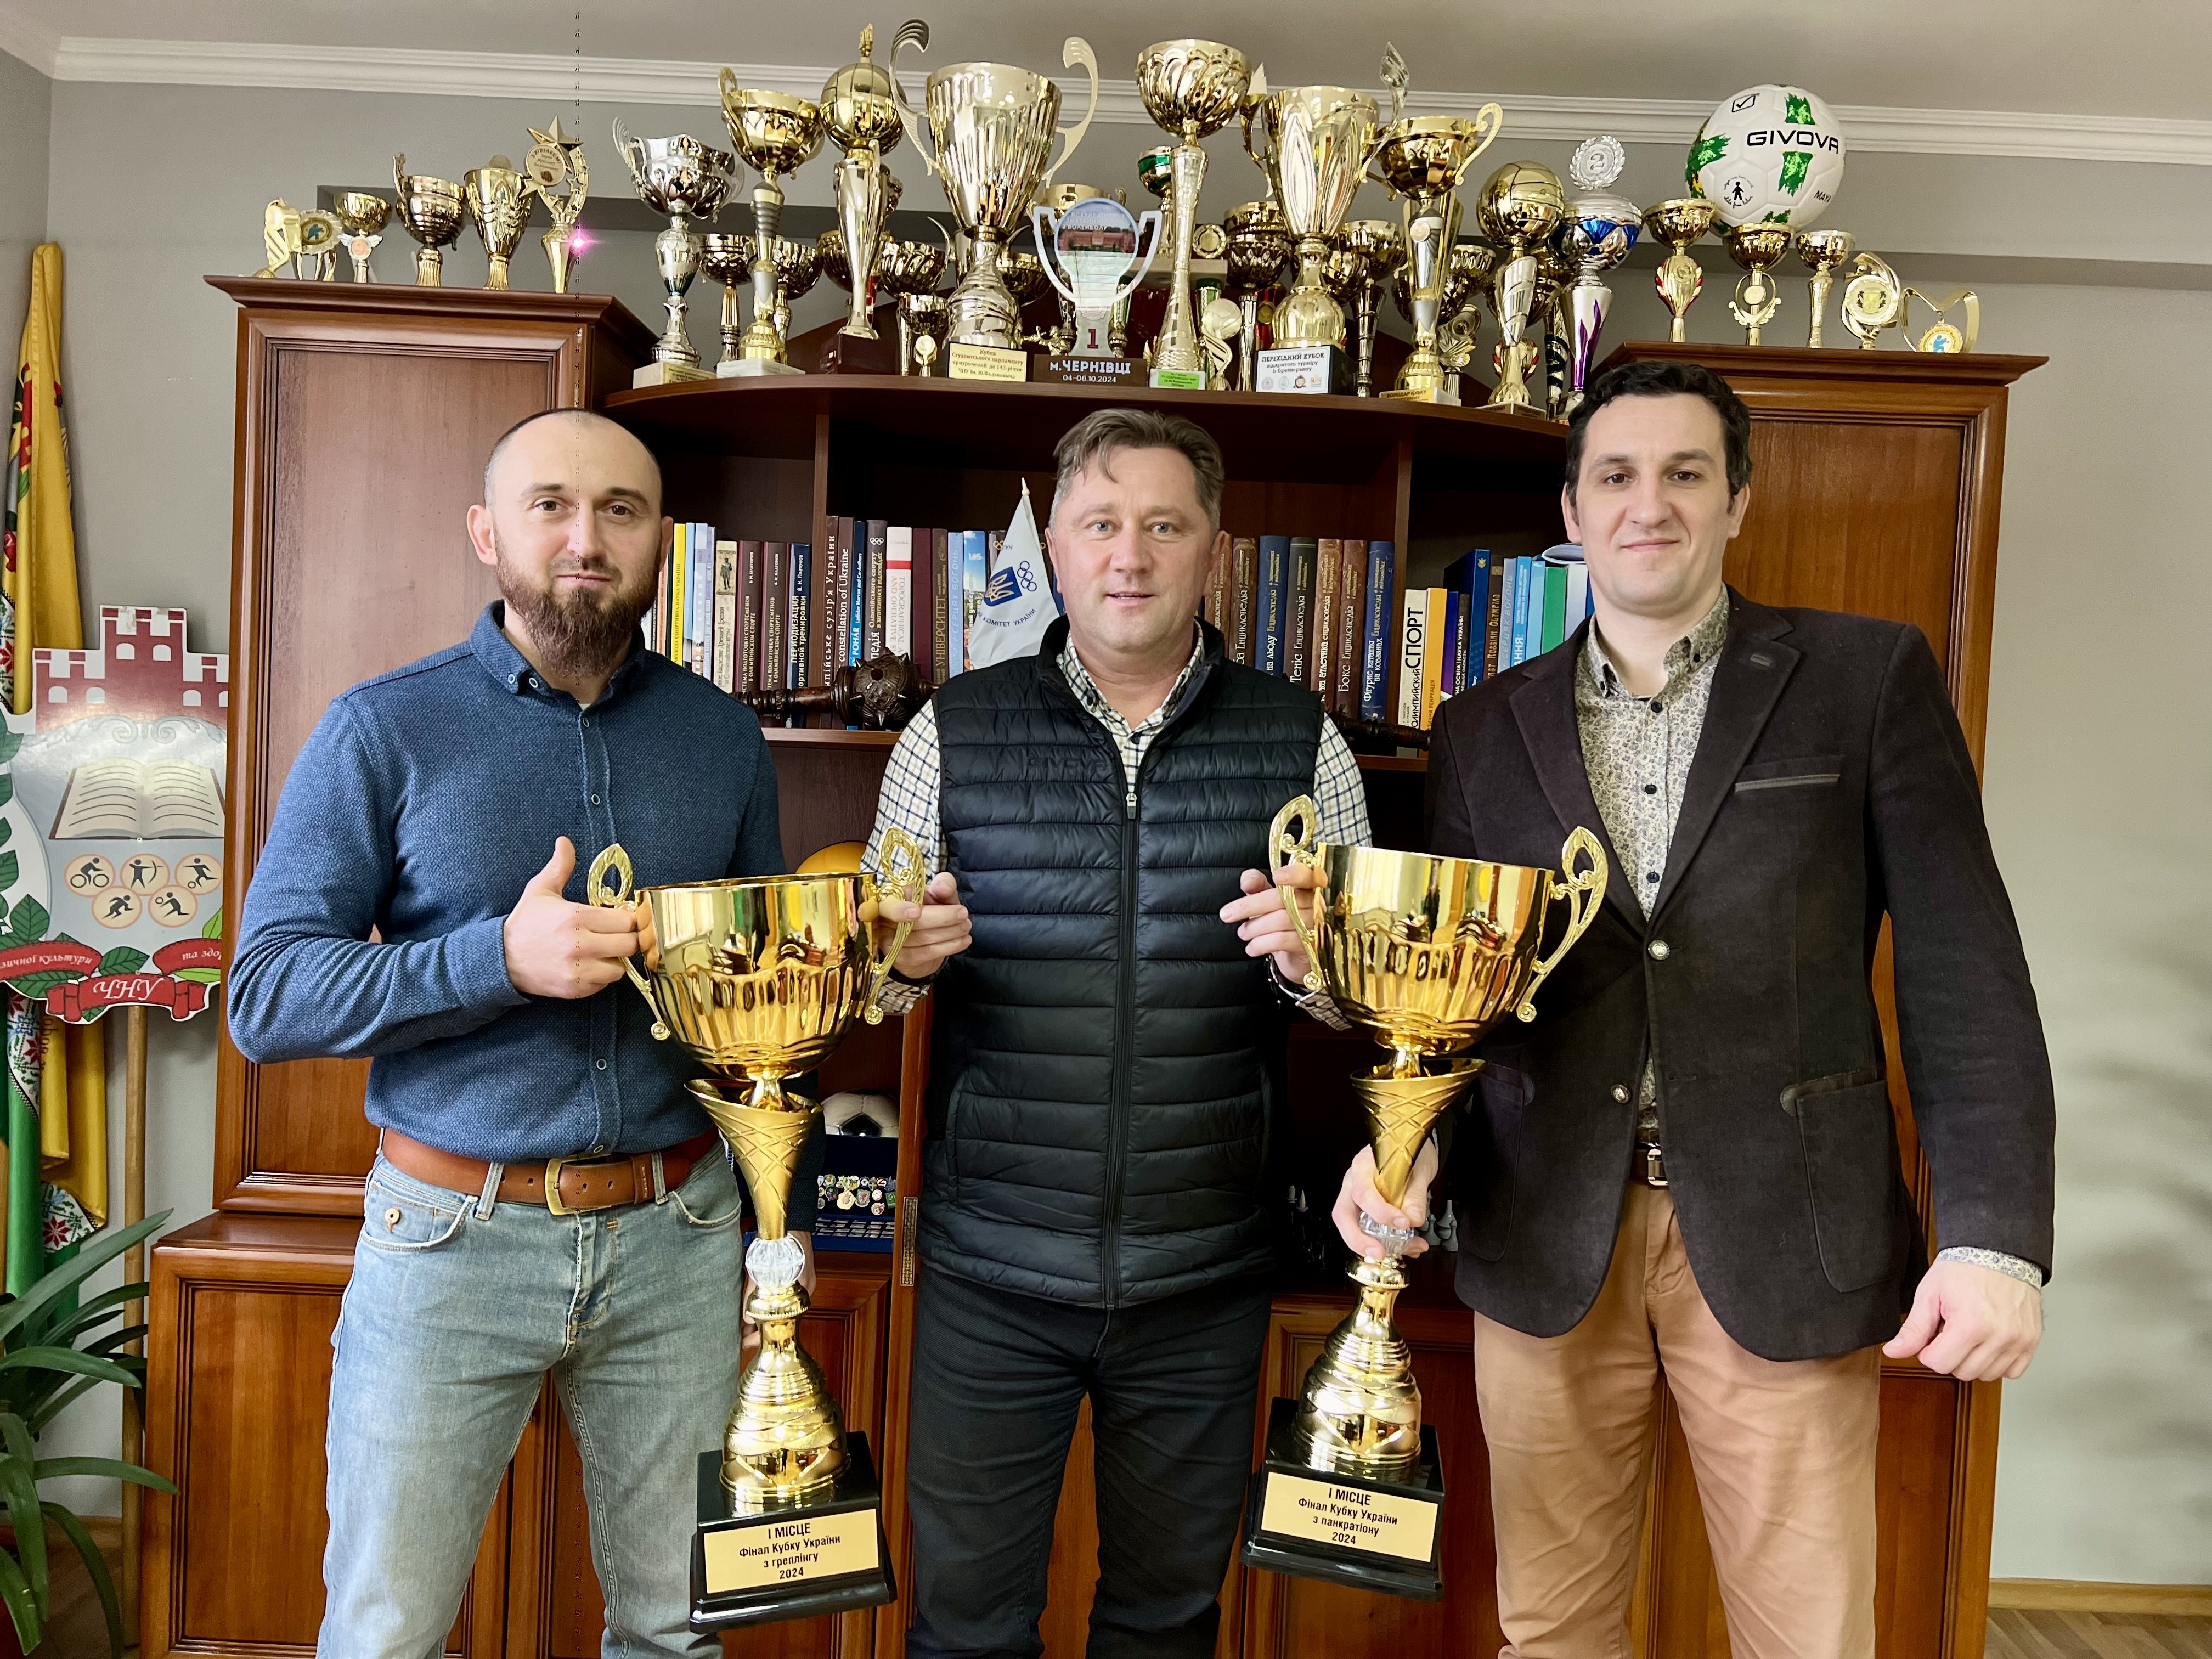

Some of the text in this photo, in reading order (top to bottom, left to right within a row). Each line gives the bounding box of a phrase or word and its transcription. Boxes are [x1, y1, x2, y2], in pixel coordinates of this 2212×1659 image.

[1747, 129, 1838, 154] GIVOVA
[1590, 153, 1605, 170] 2
[1087, 329, 1099, 349] 1
[952, 352, 991, 361] Студентського
[1262, 353, 1302, 362] ПЕРЕХІДНИЙ
[1062, 374, 1116, 383] 04-06.10.2024
[825, 535, 836, 584] України
[839, 548, 849, 586] Ukraine
[838, 589, 848, 599] of
[868, 578, 876, 628] Олімпійського
[1504, 574, 1513, 616] ВОГОНЬ
[825, 590, 835, 629] сузір'я
[951, 595, 960, 634] СЕРЦЯХ
[983, 617, 1010, 627] КОМІТЕТ
[1013, 608, 1036, 625] УКРАЇНИ
[1214, 590, 1222, 630] циклопедія
[1234, 590, 1248, 650] Енциклопедія
[1293, 595, 1306, 649] Енциклопедія
[1321, 596, 1331, 640] енциклопедія
[791, 595, 799, 663] ПЕРИОДИЗАЦИЯ
[796, 595, 807, 688] ортивной тренировки
[838, 602, 848, 662] constellation
[851, 627, 860, 656] POHÁR
[935, 595, 946, 667] УНІВЕРСИТЕТ
[1266, 589, 1277, 671] на льоду Енциклопедія
[1341, 606, 1354, 659] Енциклопедія
[1404, 607, 1423, 669] СПОРТ
[1502, 619, 1511, 659] СЕРЦЯХ
[1319, 641, 1328, 678] атлетика
[1374, 637, 1383, 682] на ковзанах
[1513, 634, 1524, 665] АННЯ:
[1290, 653, 1302, 683] Теніс
[1338, 665, 1351, 692] Бокс
[1487, 663, 1496, 679] RST
[1363, 670, 1375, 702] Фігурне
[0, 954, 93, 969] зичної культури
[182, 951, 198, 960] та
[93, 977, 165, 1001] ЧНУ
[1298, 1497, 1398, 1525] Фінал Кубку України
[1335, 1489, 1372, 1506] МІСЦЕ
[775, 1522, 811, 1538] МІСЦЕ
[1312, 1516, 1379, 1537] з панкратіону
[1331, 1532, 1356, 1545] 2024
[739, 1534, 840, 1558] Фінал Кубку України
[763, 1552, 819, 1568] з греплінгу
[779, 1567, 804, 1579] 2024
